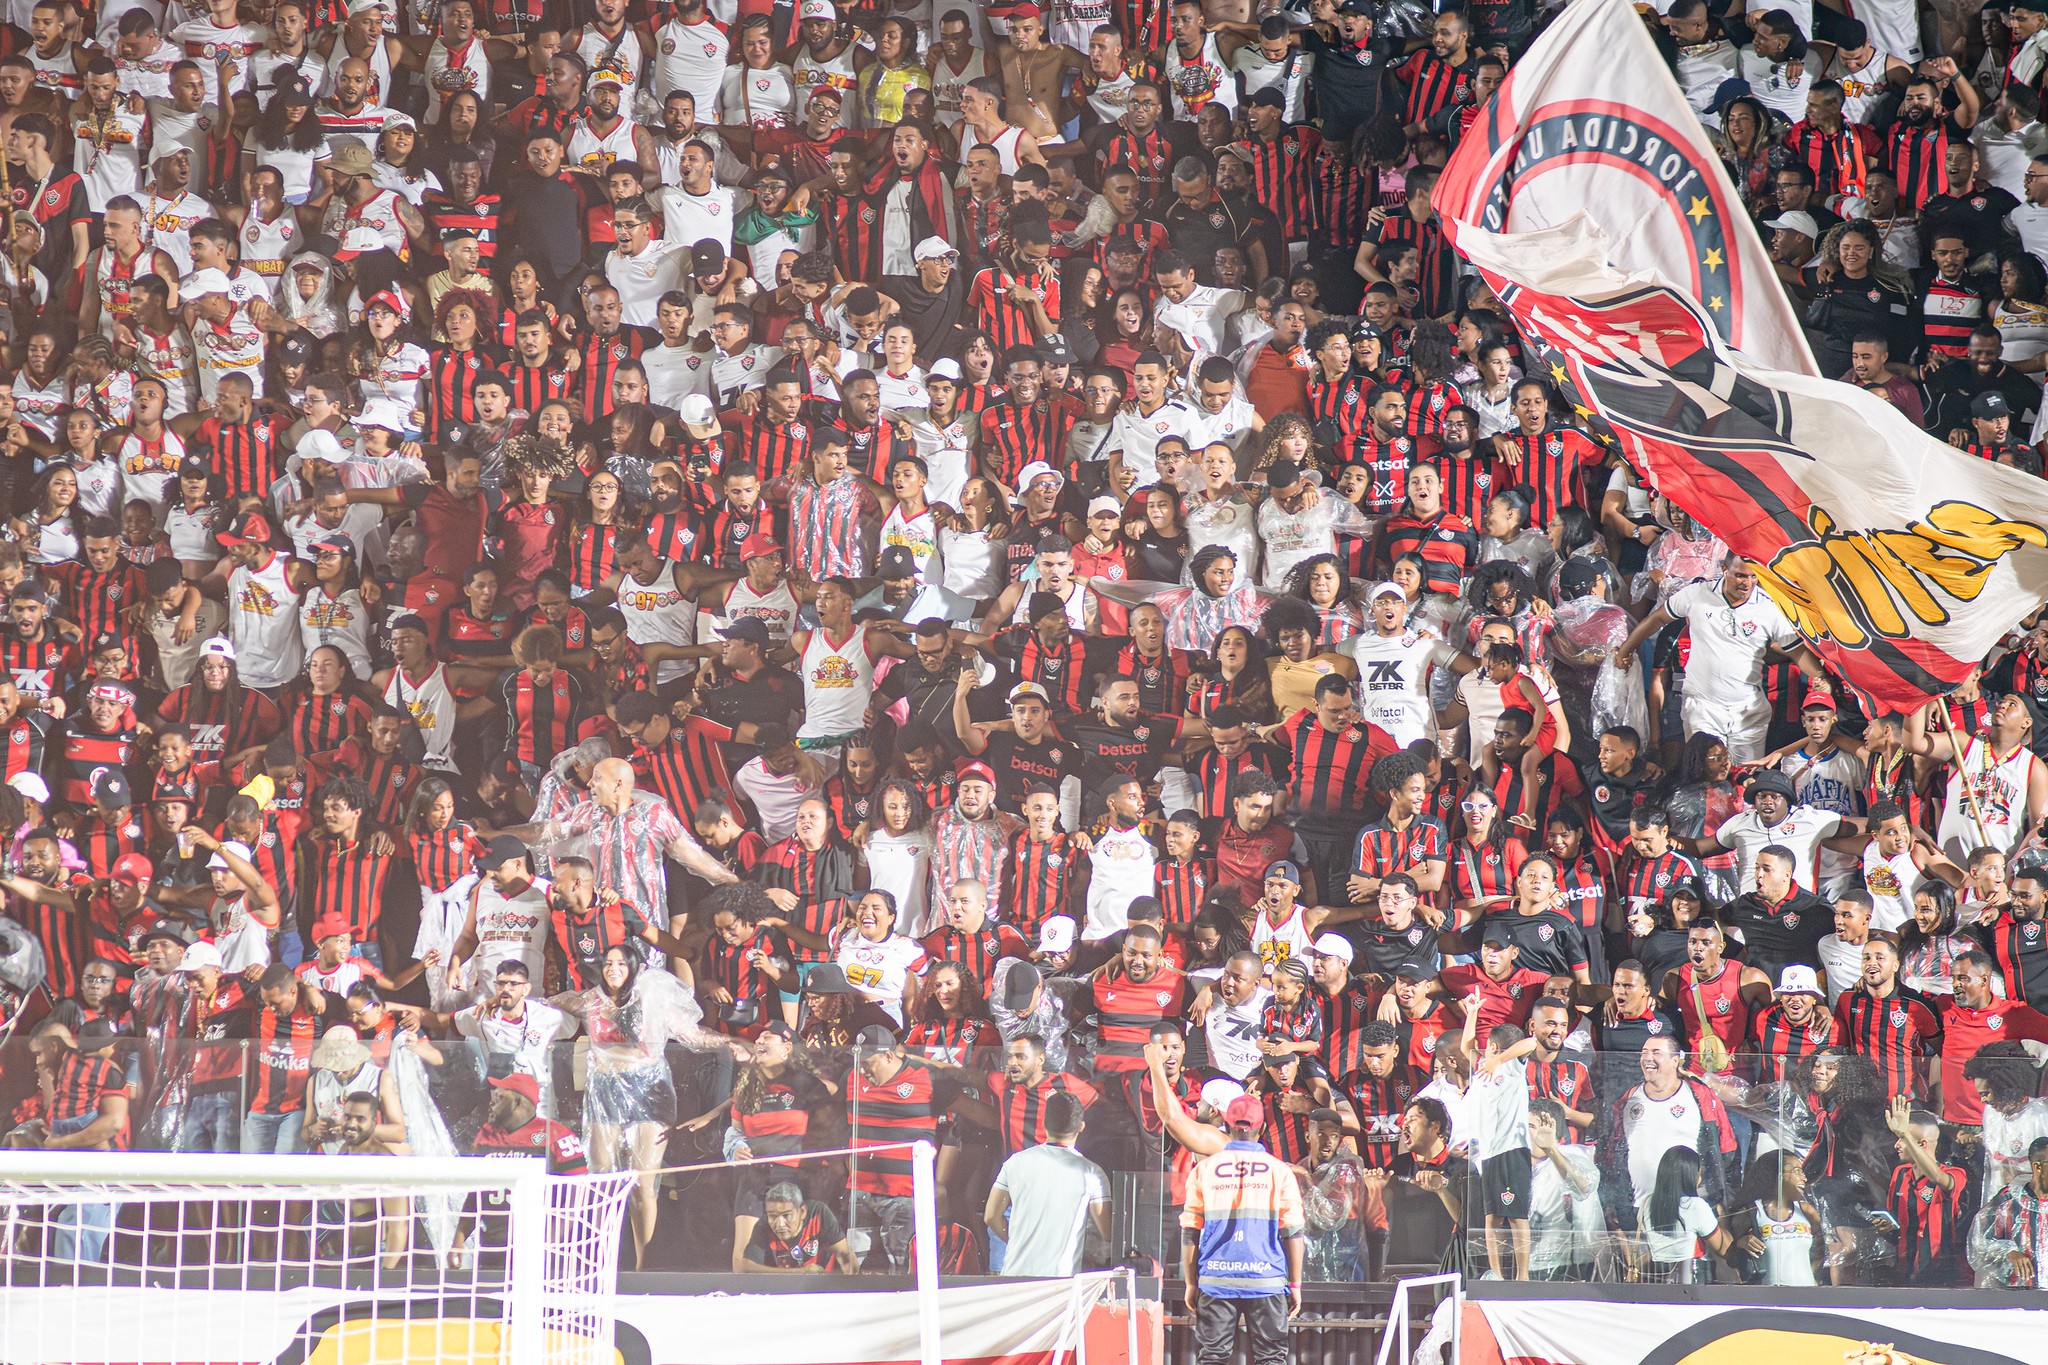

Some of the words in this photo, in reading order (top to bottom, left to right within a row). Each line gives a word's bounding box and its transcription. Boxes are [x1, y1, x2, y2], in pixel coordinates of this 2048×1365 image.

[1843, 79, 1865, 99] 97
[156, 213, 180, 234] 97
[1369, 457, 1410, 472] etsat
[635, 591, 658, 611] 97
[10, 668, 52, 691] 7K
[1368, 660, 1405, 682] 7K
[190, 724, 227, 745] 7K
[1099, 742, 1148, 756] betsat
[1011, 756, 1058, 778] betsat
[1560, 884, 1603, 901] etsat
[846, 963, 884, 988] 97
[1365, 1114, 1402, 1135] 7K
[1214, 1161, 1270, 1178] CSP
[1233, 1230, 1244, 1242] 18
[1206, 1260, 1272, 1274] SEGURANÇA
